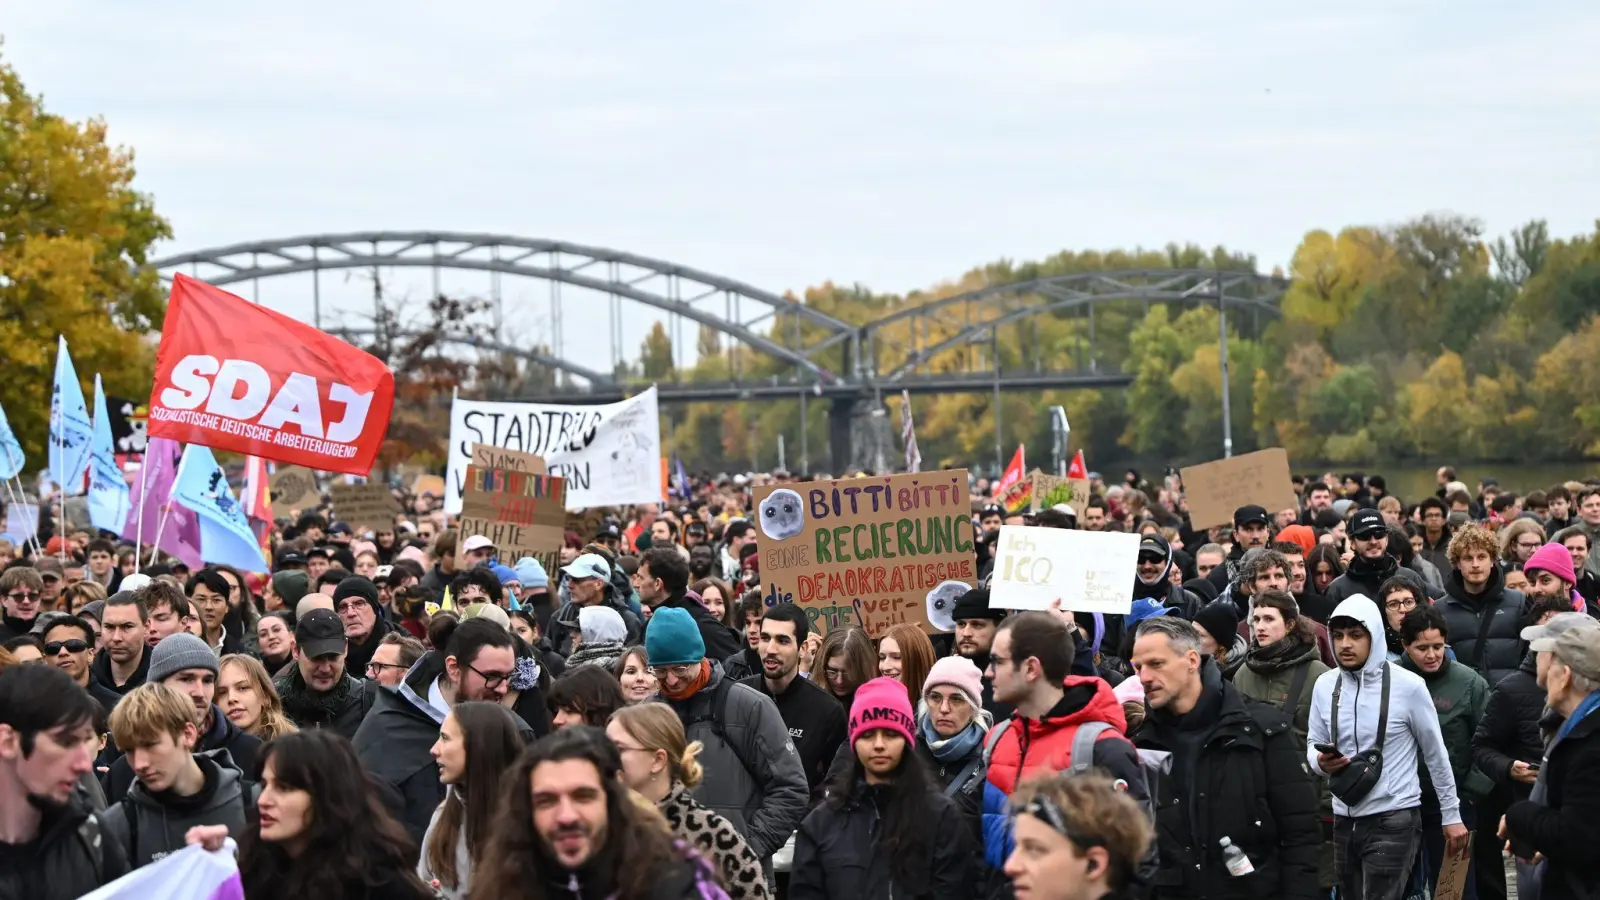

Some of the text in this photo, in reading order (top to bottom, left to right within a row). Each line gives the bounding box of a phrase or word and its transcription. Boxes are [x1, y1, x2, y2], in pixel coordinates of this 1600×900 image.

[160, 355, 374, 443] SDAJ
[220, 418, 272, 442] DEUTSCHE
[273, 429, 358, 458] ARBEITERJUGEND
[1005, 533, 1037, 551] Ich
[766, 545, 810, 570] EINE
[1002, 555, 1054, 585] ICQ
[764, 559, 973, 607] die DEMOKRATISCHE
[864, 598, 918, 614] ver-
